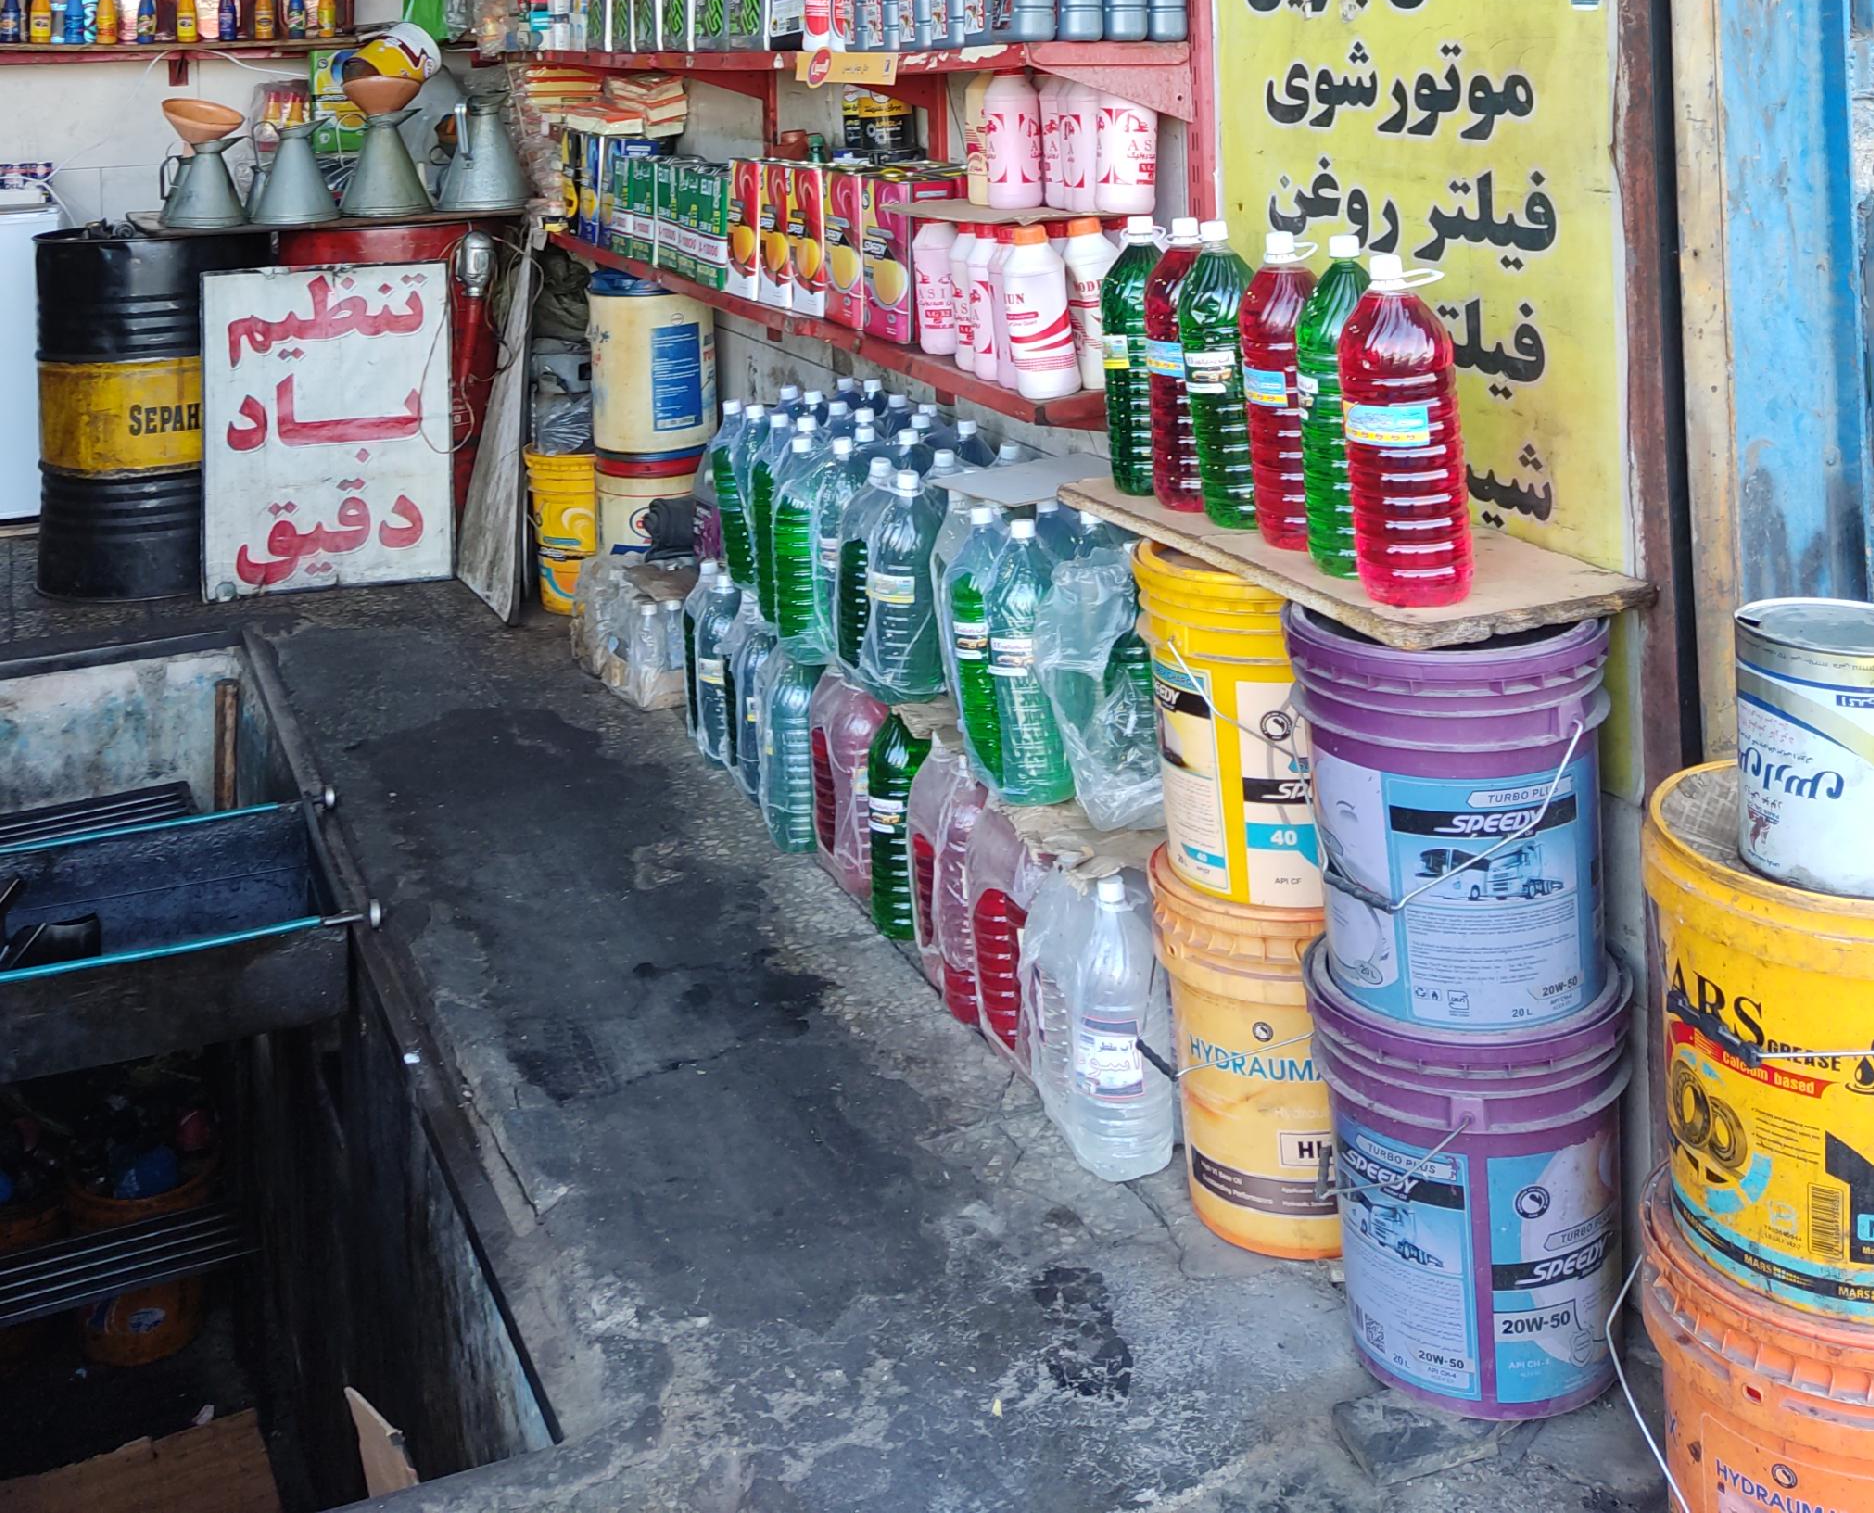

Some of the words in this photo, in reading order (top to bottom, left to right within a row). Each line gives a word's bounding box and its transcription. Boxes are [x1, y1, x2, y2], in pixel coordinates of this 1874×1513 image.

[1269, 156, 1399, 253] روغن
[1414, 171, 1557, 271] فیلتر
[227, 274, 428, 369] تنظیم
[227, 373, 422, 463] باد
[236, 478, 425, 584] دقیق
[1488, 791, 1529, 804] TURBO
[1433, 810, 1541, 834] SPEEDY
[1270, 830, 1297, 846] 40
[1542, 975, 1578, 997] 20W-50
[1512, 1008, 1524, 1018] 20
[1527, 1008, 1533, 1016] L
[1190, 1033, 1325, 1082] HYDRAUM
[1767, 1039, 1841, 1072] GREASE
[1773, 1072, 1815, 1094] based
[1367, 1143, 1402, 1165] TURBO
[1342, 1149, 1419, 1193] SPEEDY
[1560, 1224, 1594, 1243] TURBO
[1515, 1236, 1611, 1285] SPEEDY
[1744, 1253, 1772, 1272] MARS
[1838, 1287, 1870, 1300] MARS
[1502, 1311, 1571, 1335] 20W-50
[1418, 1350, 1464, 1369] 20W-50
